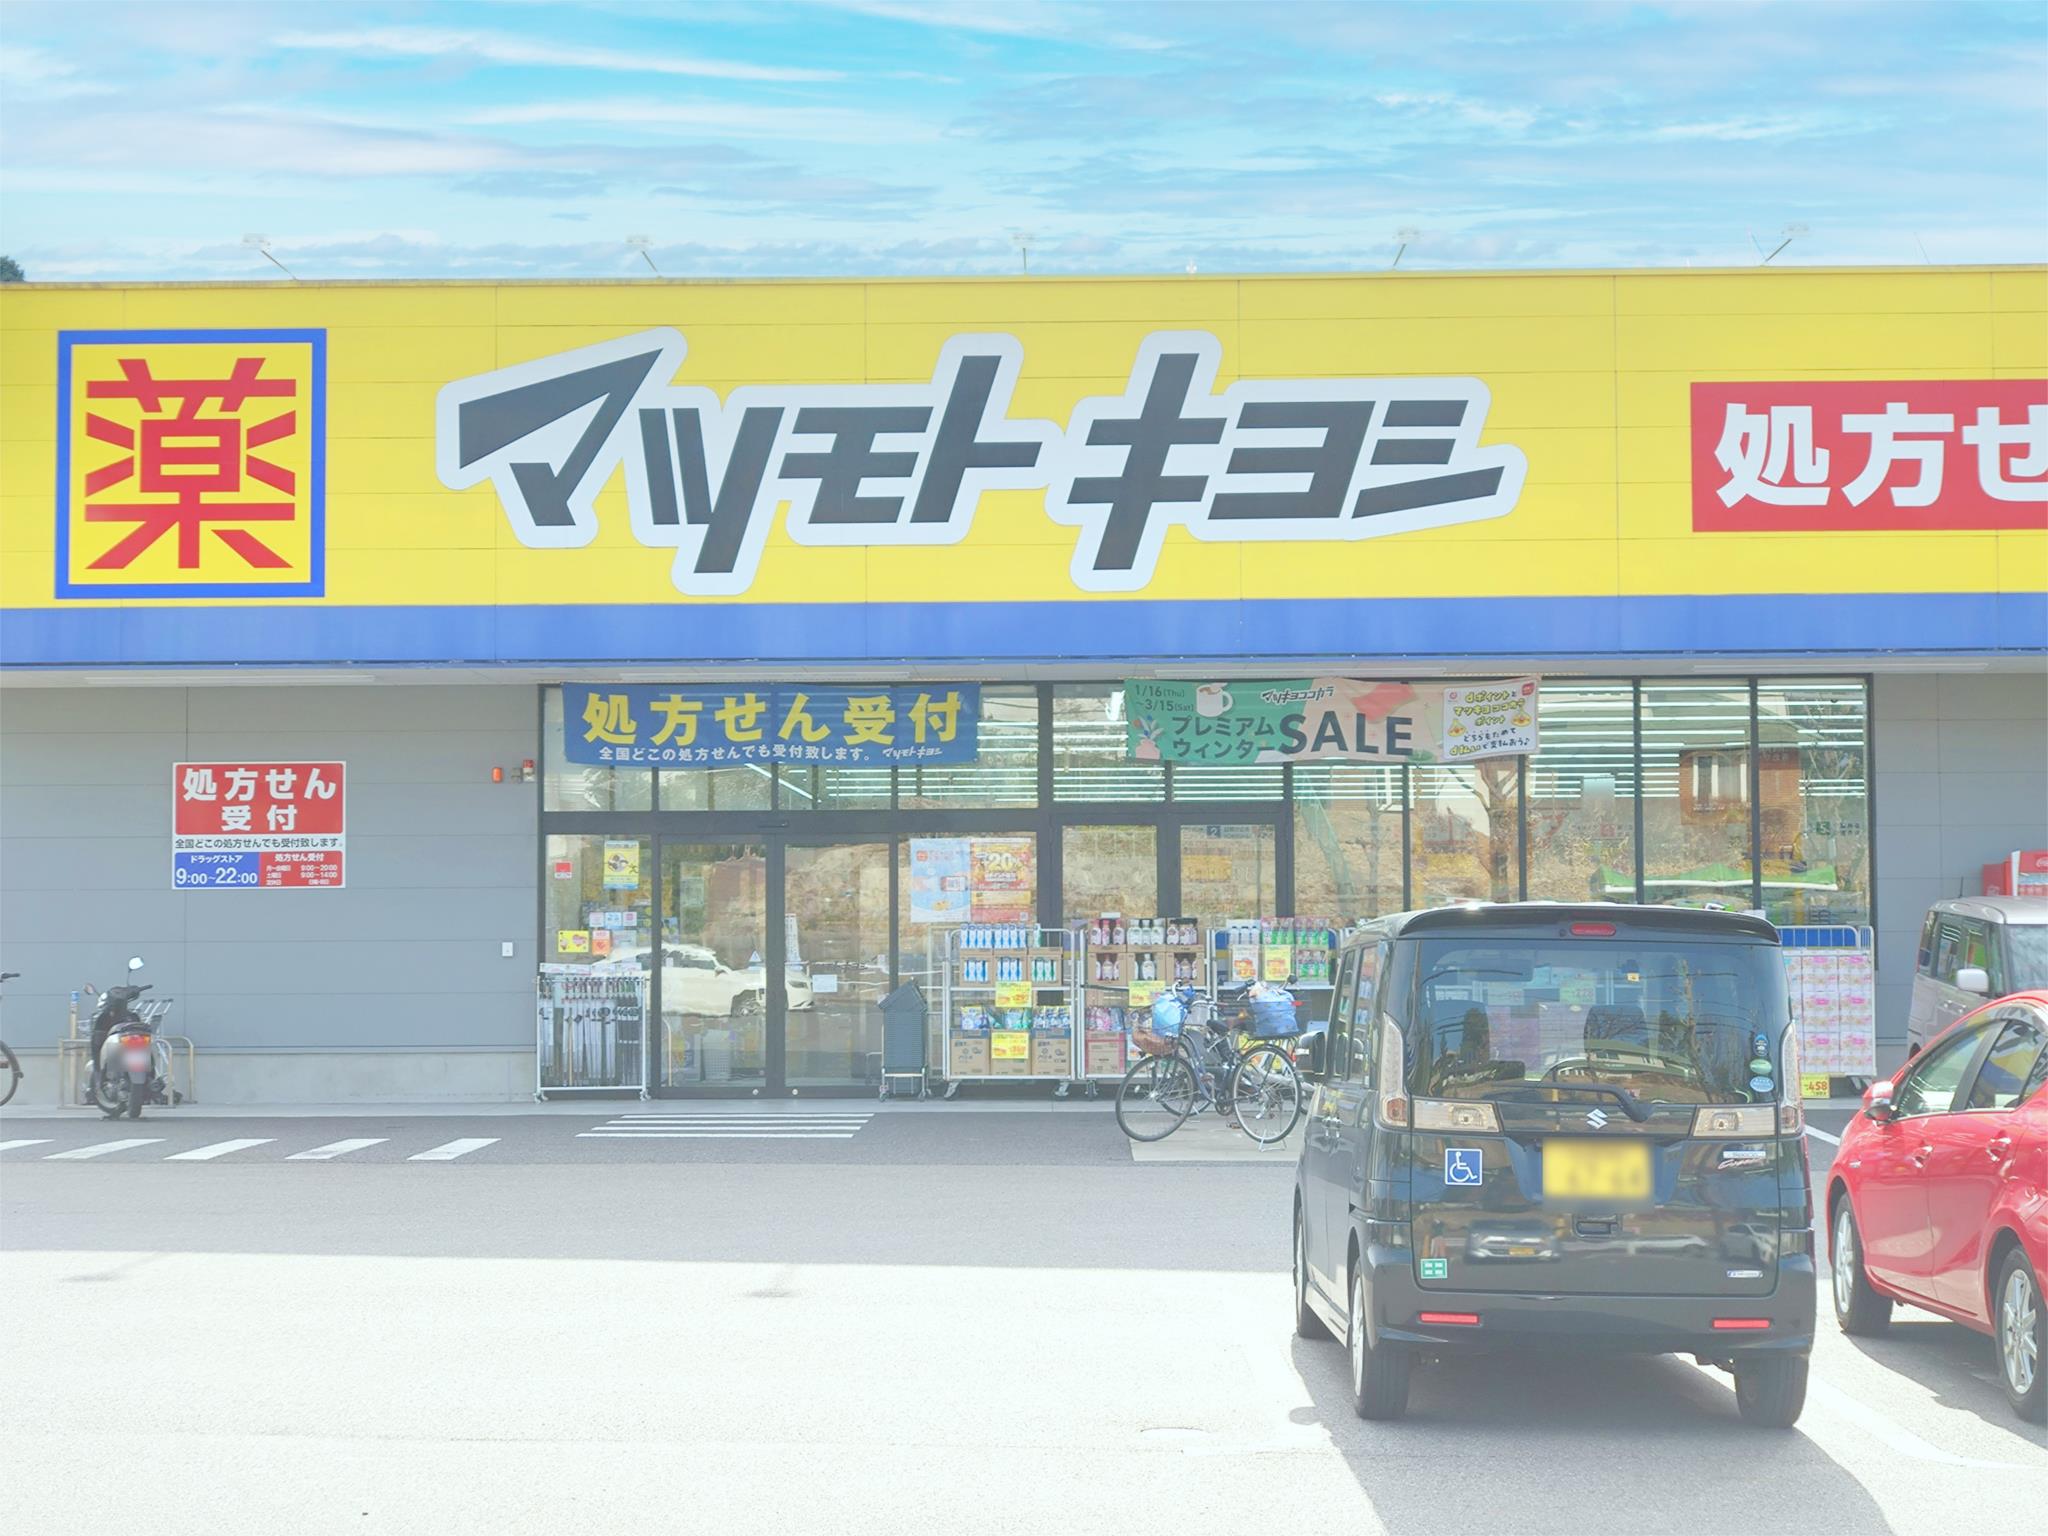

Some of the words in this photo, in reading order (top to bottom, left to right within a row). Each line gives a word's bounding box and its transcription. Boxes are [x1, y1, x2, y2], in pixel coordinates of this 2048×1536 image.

[84, 357, 297, 570] 薬
[459, 346, 1506, 573] マツモトキヨシ
[582, 690, 962, 747] 処方せん受付
[1172, 715, 1275, 737] プレミアム
[1279, 710, 1414, 756] SALE
[599, 743, 871, 761] 全国どこの処方せんでも受付致します。
[882, 746, 943, 759] マツモトキヨシ
[1172, 737, 1275, 760] ウィンター
[182, 767, 336, 802] 処方せん
[221, 804, 298, 831] 受付
[190, 854, 243, 864] ドラッグストア
[274, 852, 325, 862] 処方せん受付
[1808, 1081, 1828, 1091] 458
